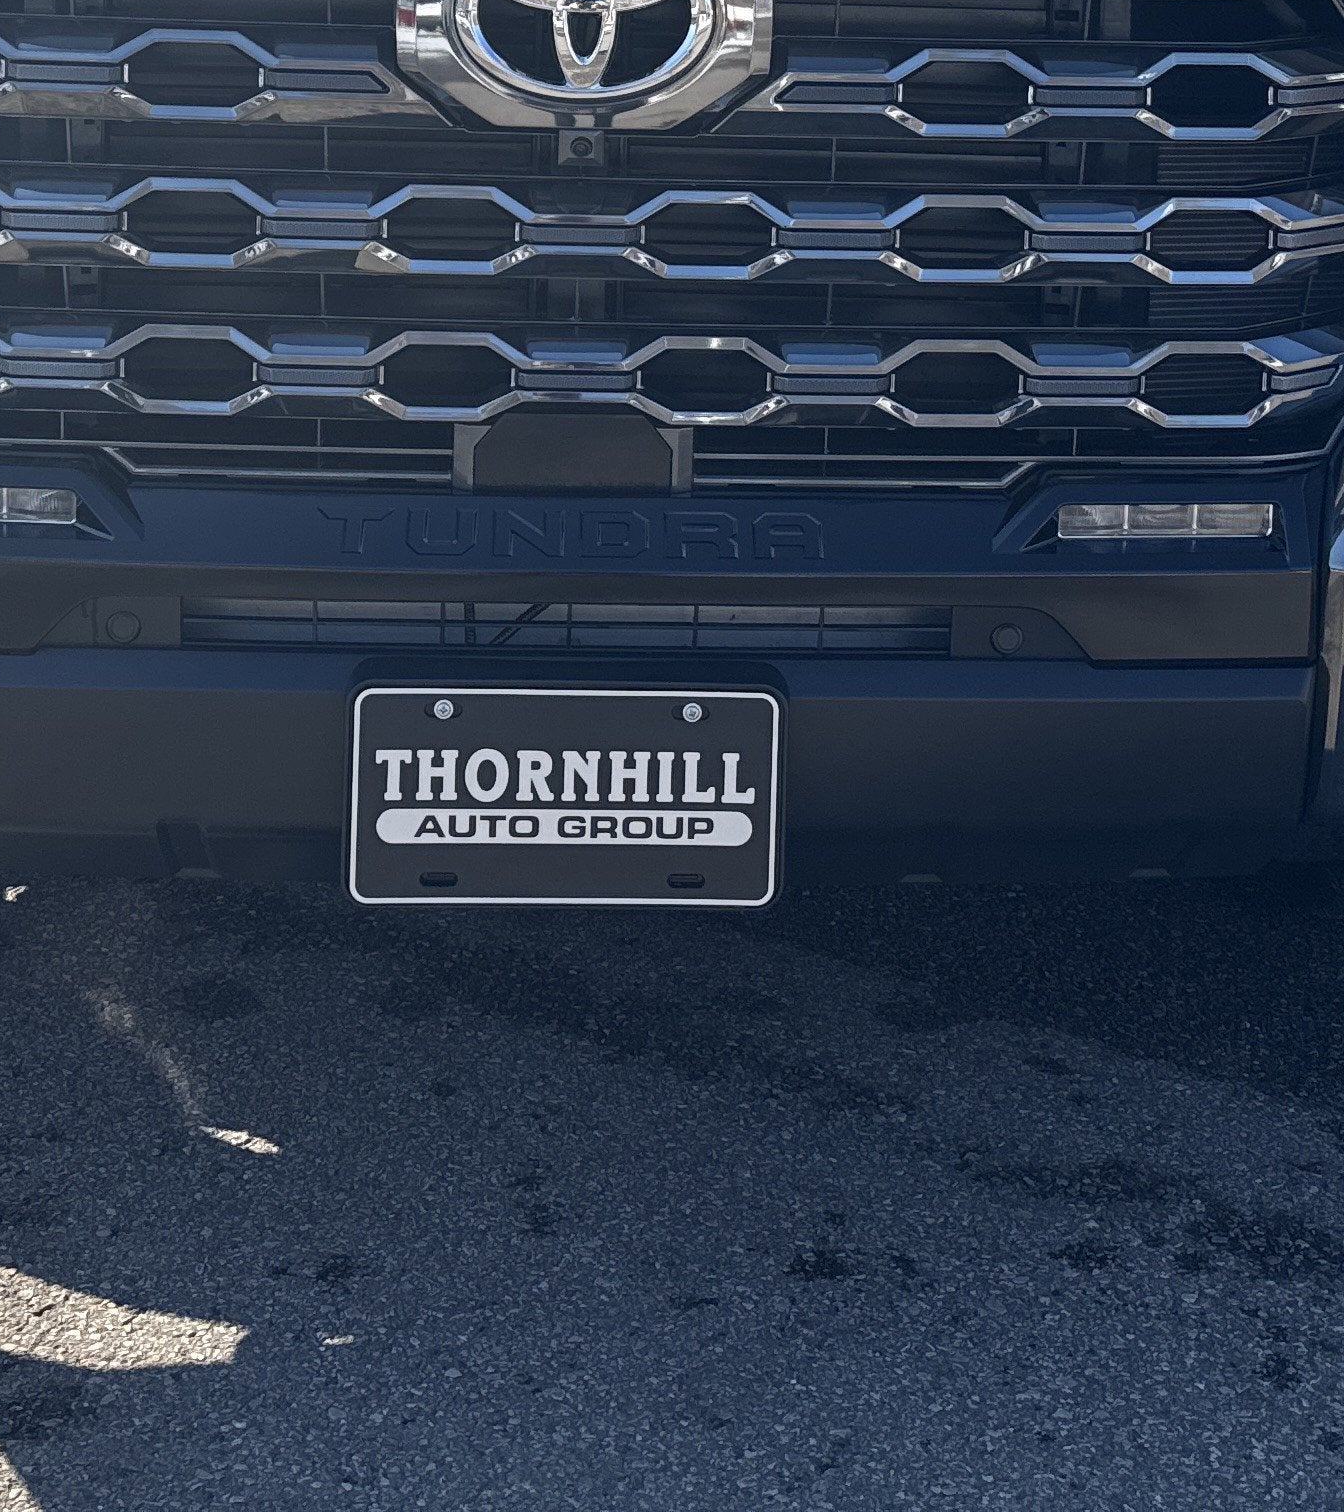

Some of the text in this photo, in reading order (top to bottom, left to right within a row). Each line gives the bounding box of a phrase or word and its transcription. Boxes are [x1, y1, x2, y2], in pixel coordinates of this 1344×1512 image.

[319, 508, 825, 559] TUNDRA
[375, 748, 755, 804] THORNHILL
[414, 816, 713, 839] AUTO GROUP
